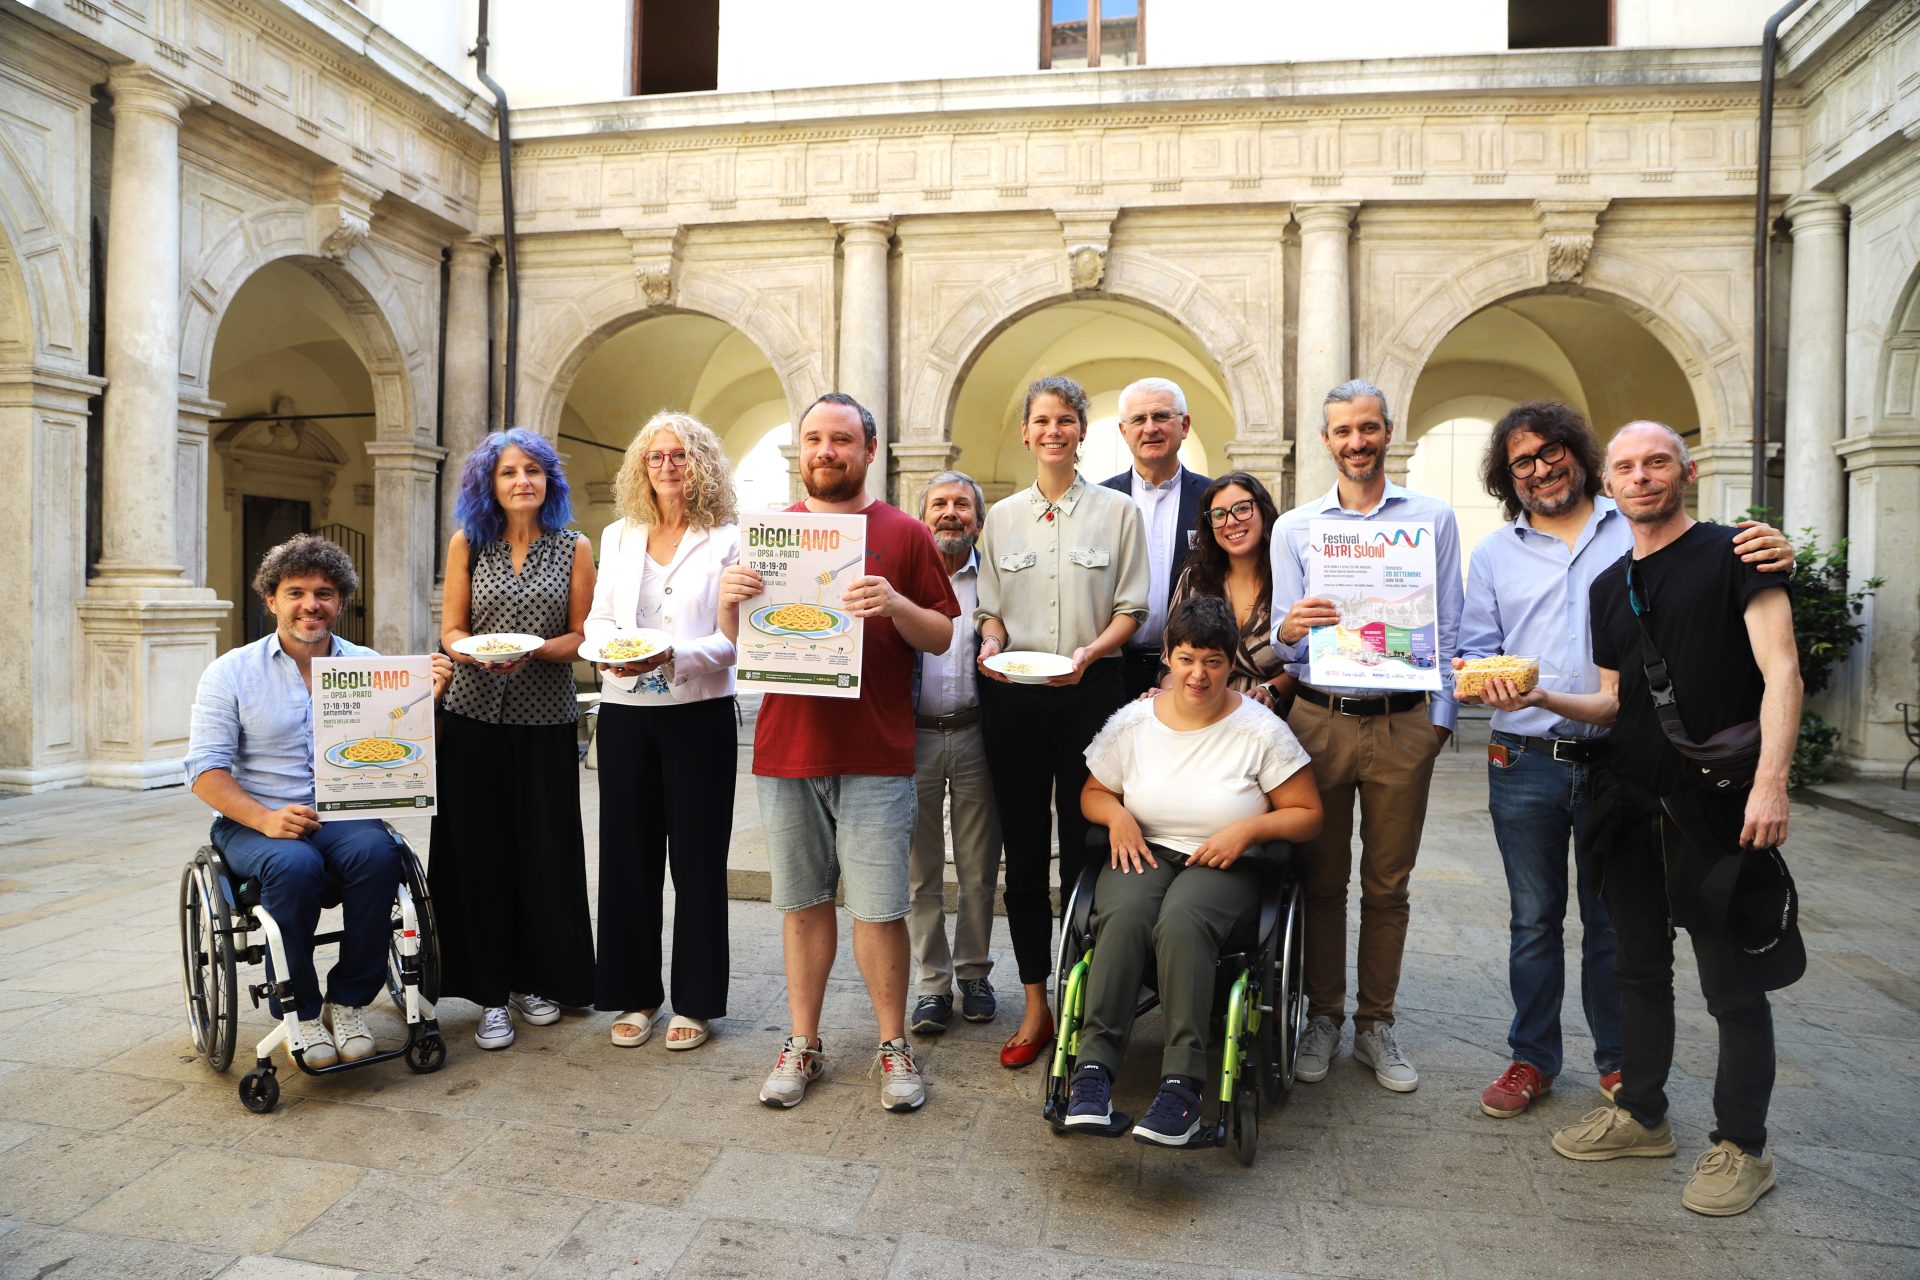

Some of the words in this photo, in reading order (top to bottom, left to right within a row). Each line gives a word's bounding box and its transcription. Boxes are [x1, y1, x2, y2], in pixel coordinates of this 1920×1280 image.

[749, 523, 840, 552] BÌGOLIAMO
[1322, 533, 1359, 544] Festival
[757, 549, 774, 557] OPSA
[779, 550, 800, 558] PRATO
[1323, 544, 1351, 558] ALTRI
[1354, 541, 1385, 558] SUONI
[321, 668, 410, 690] BÌGOLIAMO
[330, 691, 347, 699] OPSA
[352, 690, 372, 698] PRATO
